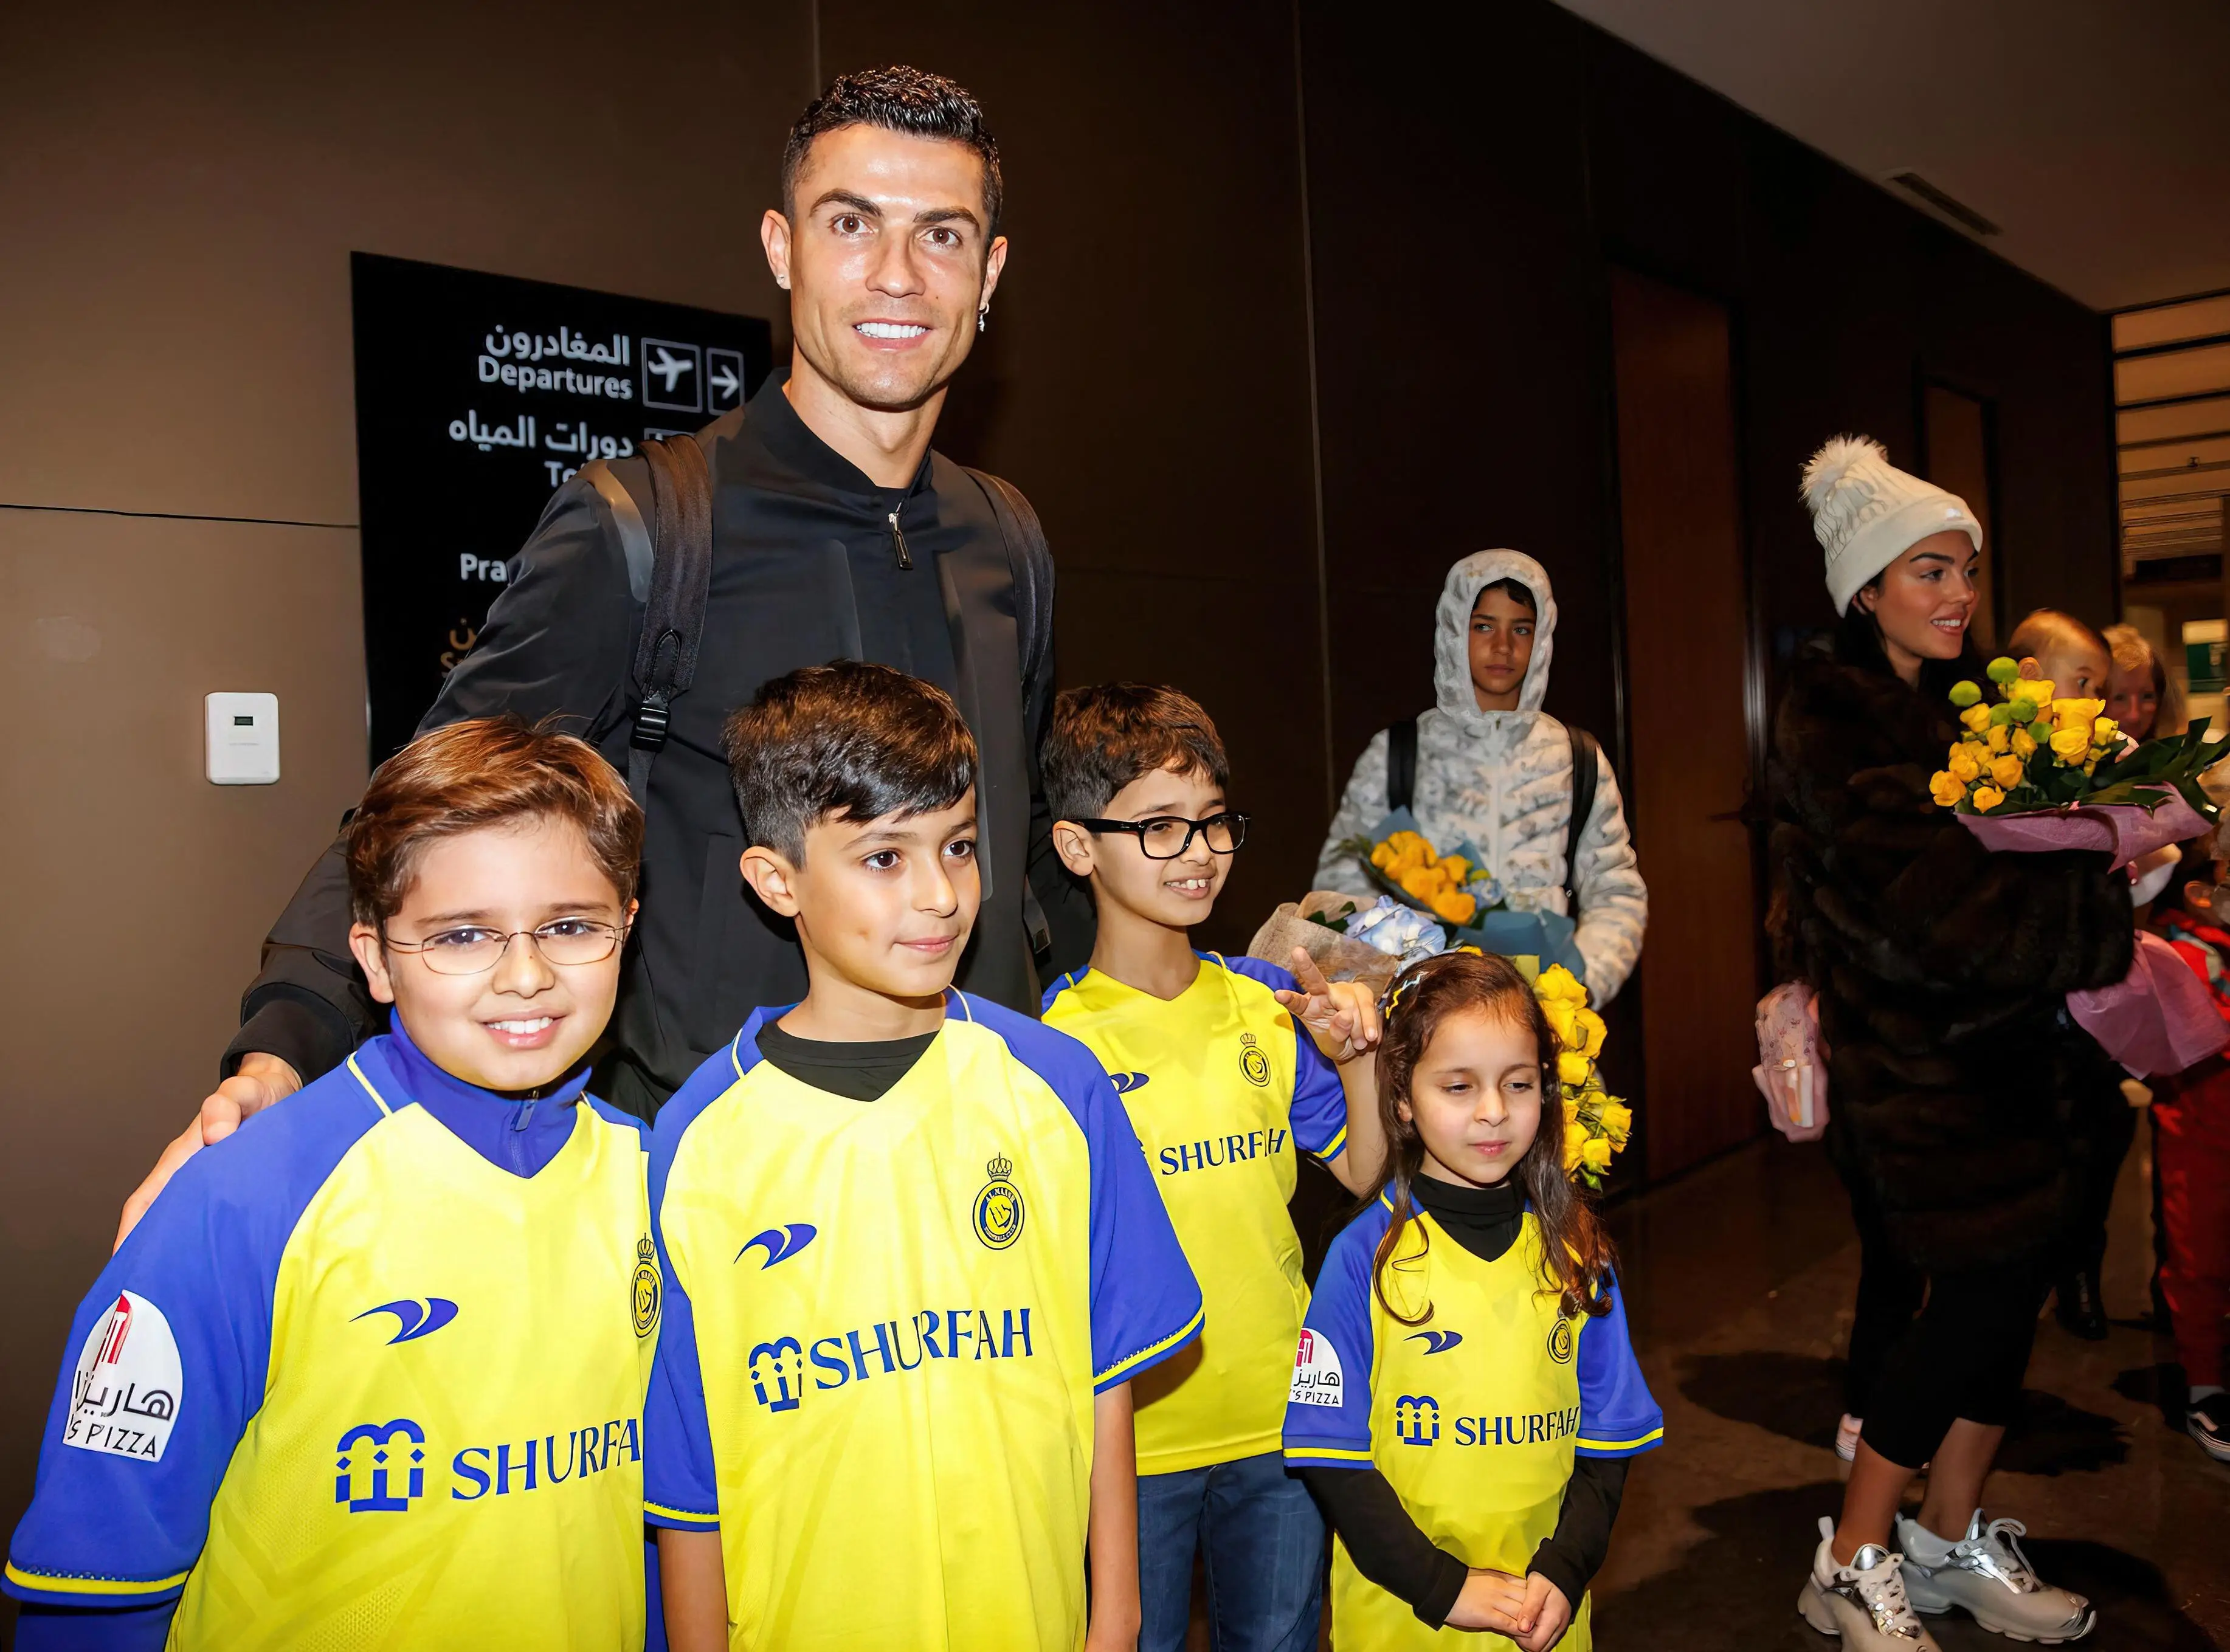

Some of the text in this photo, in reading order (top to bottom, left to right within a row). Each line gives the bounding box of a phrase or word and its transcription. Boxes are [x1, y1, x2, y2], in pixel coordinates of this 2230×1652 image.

[486, 324, 630, 367] المغادرون
[478, 354, 633, 400] Departures
[448, 409, 633, 461] دورات المياه
[460, 552, 508, 582] Pra
[809, 1307, 1034, 1390] SHURFAH
[1305, 1391, 1339, 1405] PIZZA
[85, 1423, 156, 1458] PIZZA
[1455, 1406, 1580, 1447] SHURFAH
[452, 1418, 641, 1500] SHURFA
